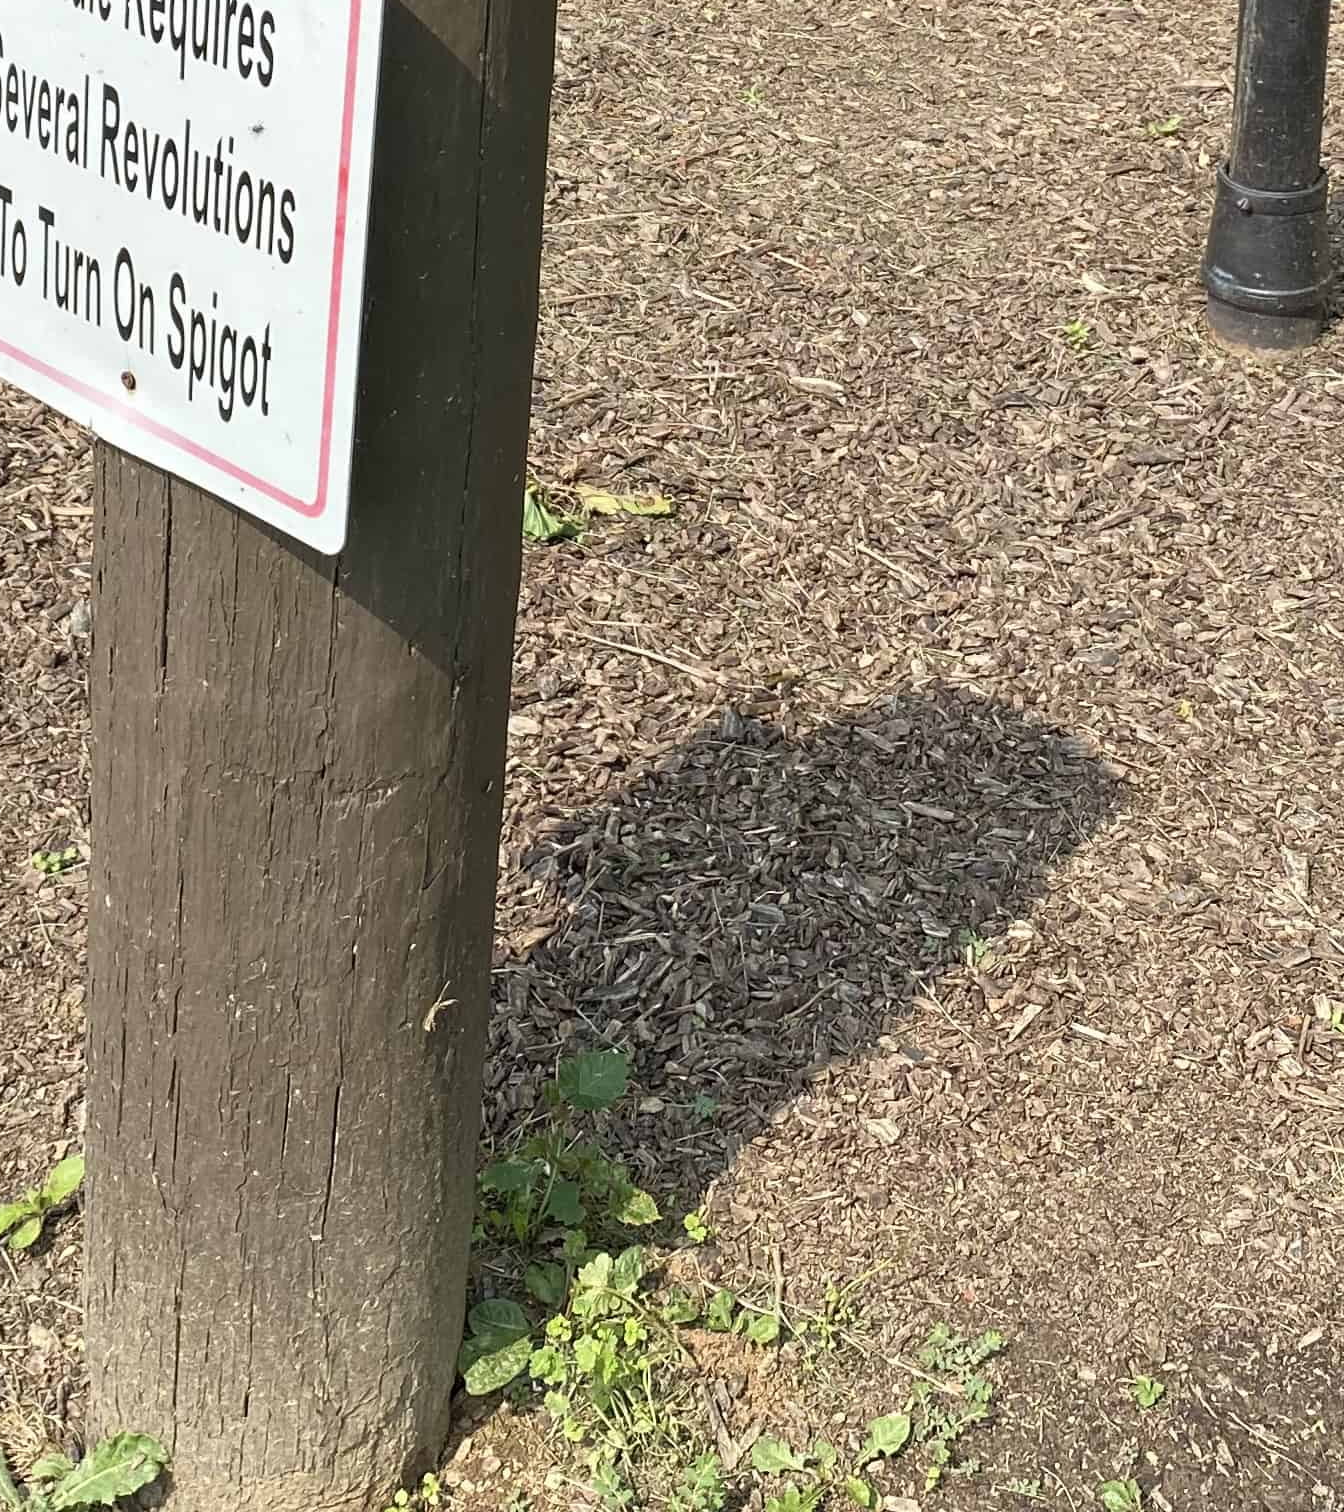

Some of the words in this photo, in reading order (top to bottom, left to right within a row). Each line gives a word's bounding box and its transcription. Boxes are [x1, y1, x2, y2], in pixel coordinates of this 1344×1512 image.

[100, 83, 296, 265] Revolutions
[38, 206, 102, 328] Turn
[113, 247, 155, 356] On
[167, 272, 273, 424] Spigot
